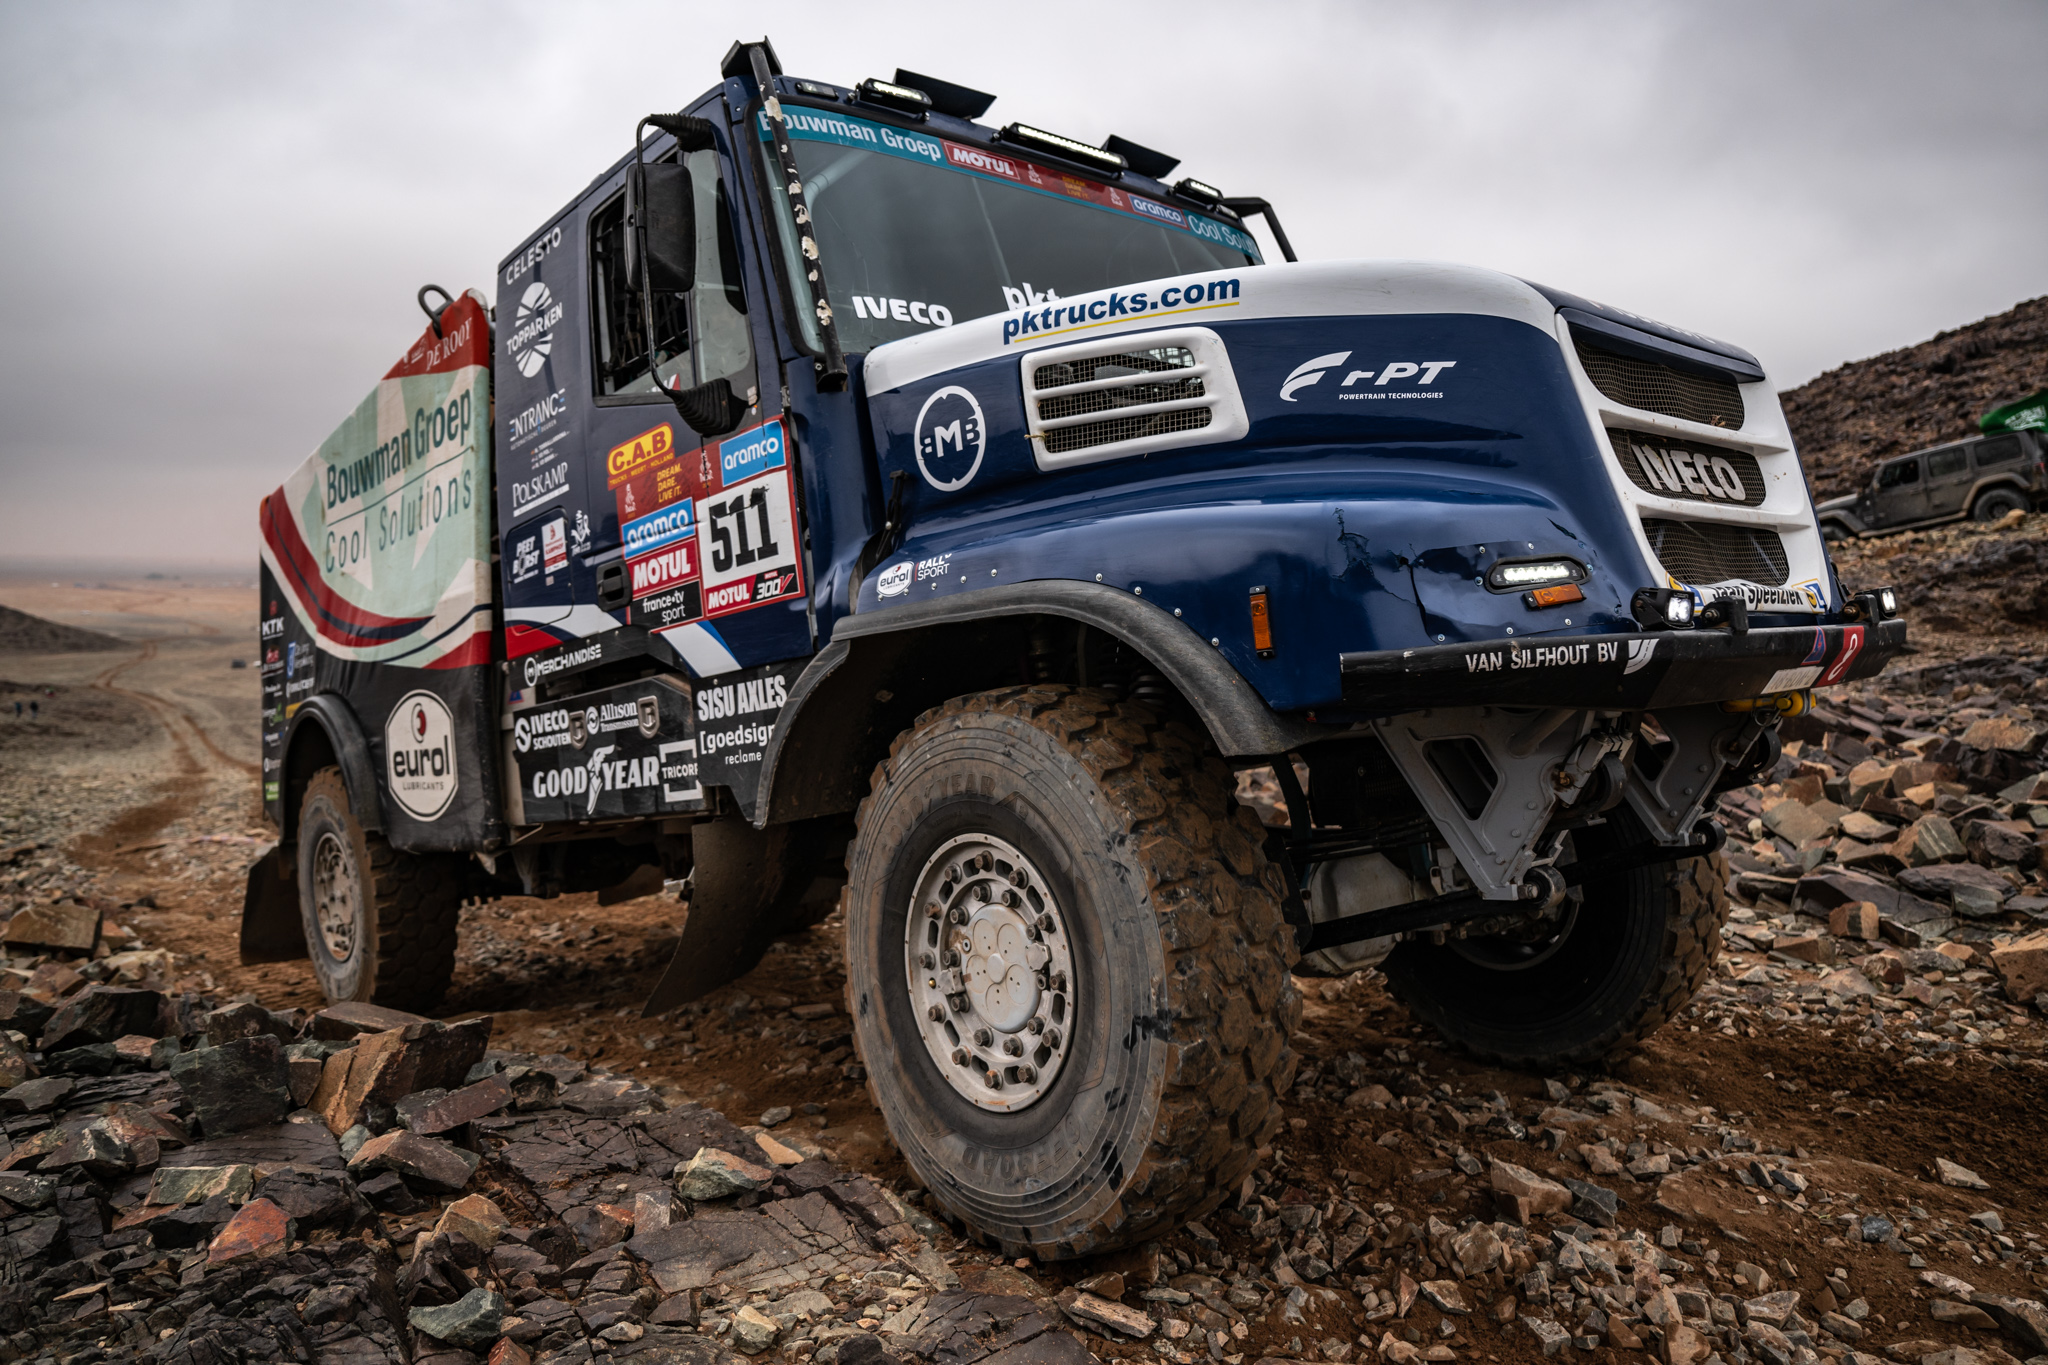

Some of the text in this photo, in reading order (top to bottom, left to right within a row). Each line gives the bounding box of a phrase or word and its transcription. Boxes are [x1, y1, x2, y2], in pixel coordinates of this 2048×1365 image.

[881, 128, 942, 162] Groep
[953, 148, 1014, 176] MOTUL
[1133, 199, 1181, 222] aramco
[1188, 215, 1223, 243] Cool
[505, 226, 562, 286] CELESTO
[506, 302, 563, 355] TOPPARKEN
[852, 296, 953, 327] IVECO
[1003, 278, 1240, 345] pktrucks.com
[326, 388, 472, 510] Bouwman Groep
[612, 430, 667, 472] C.A.B
[724, 437, 780, 471] aramco
[512, 461, 569, 508] POLSKAMP
[1630, 443, 1746, 501] IVECO
[658, 488, 673, 503] LIVE
[325, 516, 369, 574] Cool
[379, 468, 472, 552] Solutions
[627, 509, 689, 550] aramco
[709, 486, 780, 574] 511
[633, 548, 691, 592] MOTUL
[756, 573, 795, 600] 300V
[880, 568, 909, 587] eurol
[917, 563, 951, 581] SPORT
[708, 583, 750, 610] MOTUL
[661, 605, 686, 627] sport
[536, 643, 603, 677] MERCHANDISE
[1465, 641, 1619, 673] VAN SILFHOUT BV
[601, 702, 638, 722] Allison
[697, 674, 788, 722] SISU AXLES
[530, 708, 569, 736] IVECO
[393, 734, 451, 778] eurol
[725, 748, 763, 765] reclame
[402, 781, 444, 791] LUBRICANTS
